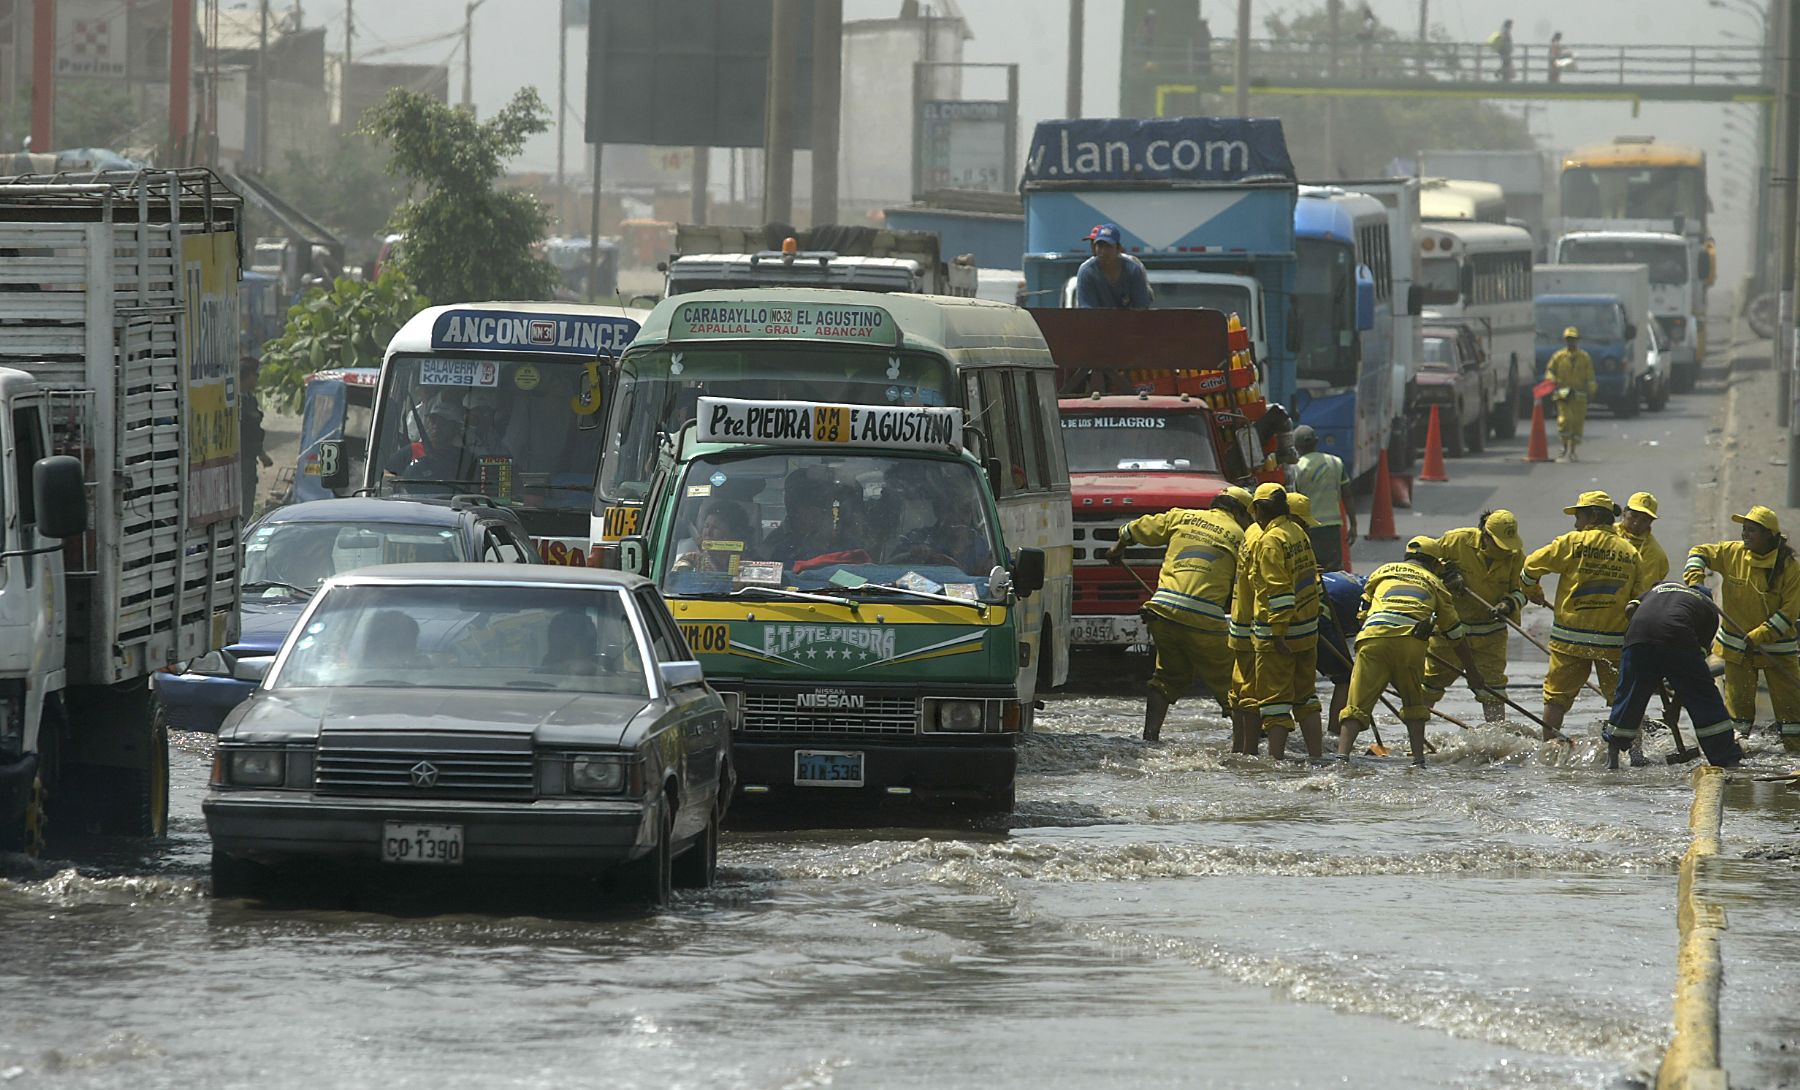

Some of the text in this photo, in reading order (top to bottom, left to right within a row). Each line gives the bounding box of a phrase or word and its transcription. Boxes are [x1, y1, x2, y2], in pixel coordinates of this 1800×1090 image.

[684, 308, 767, 324] CARABAYLLO
[797, 310, 812, 325] EL
[816, 310, 882, 327] AGUSTINO
[442, 316, 529, 345] ANCON
[557, 320, 629, 349] LINCE
[690, 324, 750, 334] ZAPALLAL
[815, 326, 874, 338] ABANCAY
[424, 359, 479, 376] SALAVERRY
[747, 407, 811, 440] PIEDRA
[1068, 419, 1077, 428] DE
[1078, 418, 1092, 428] LOS
[1094, 417, 1167, 429] MILAGROS
[797, 694, 864, 708] NISSAN
